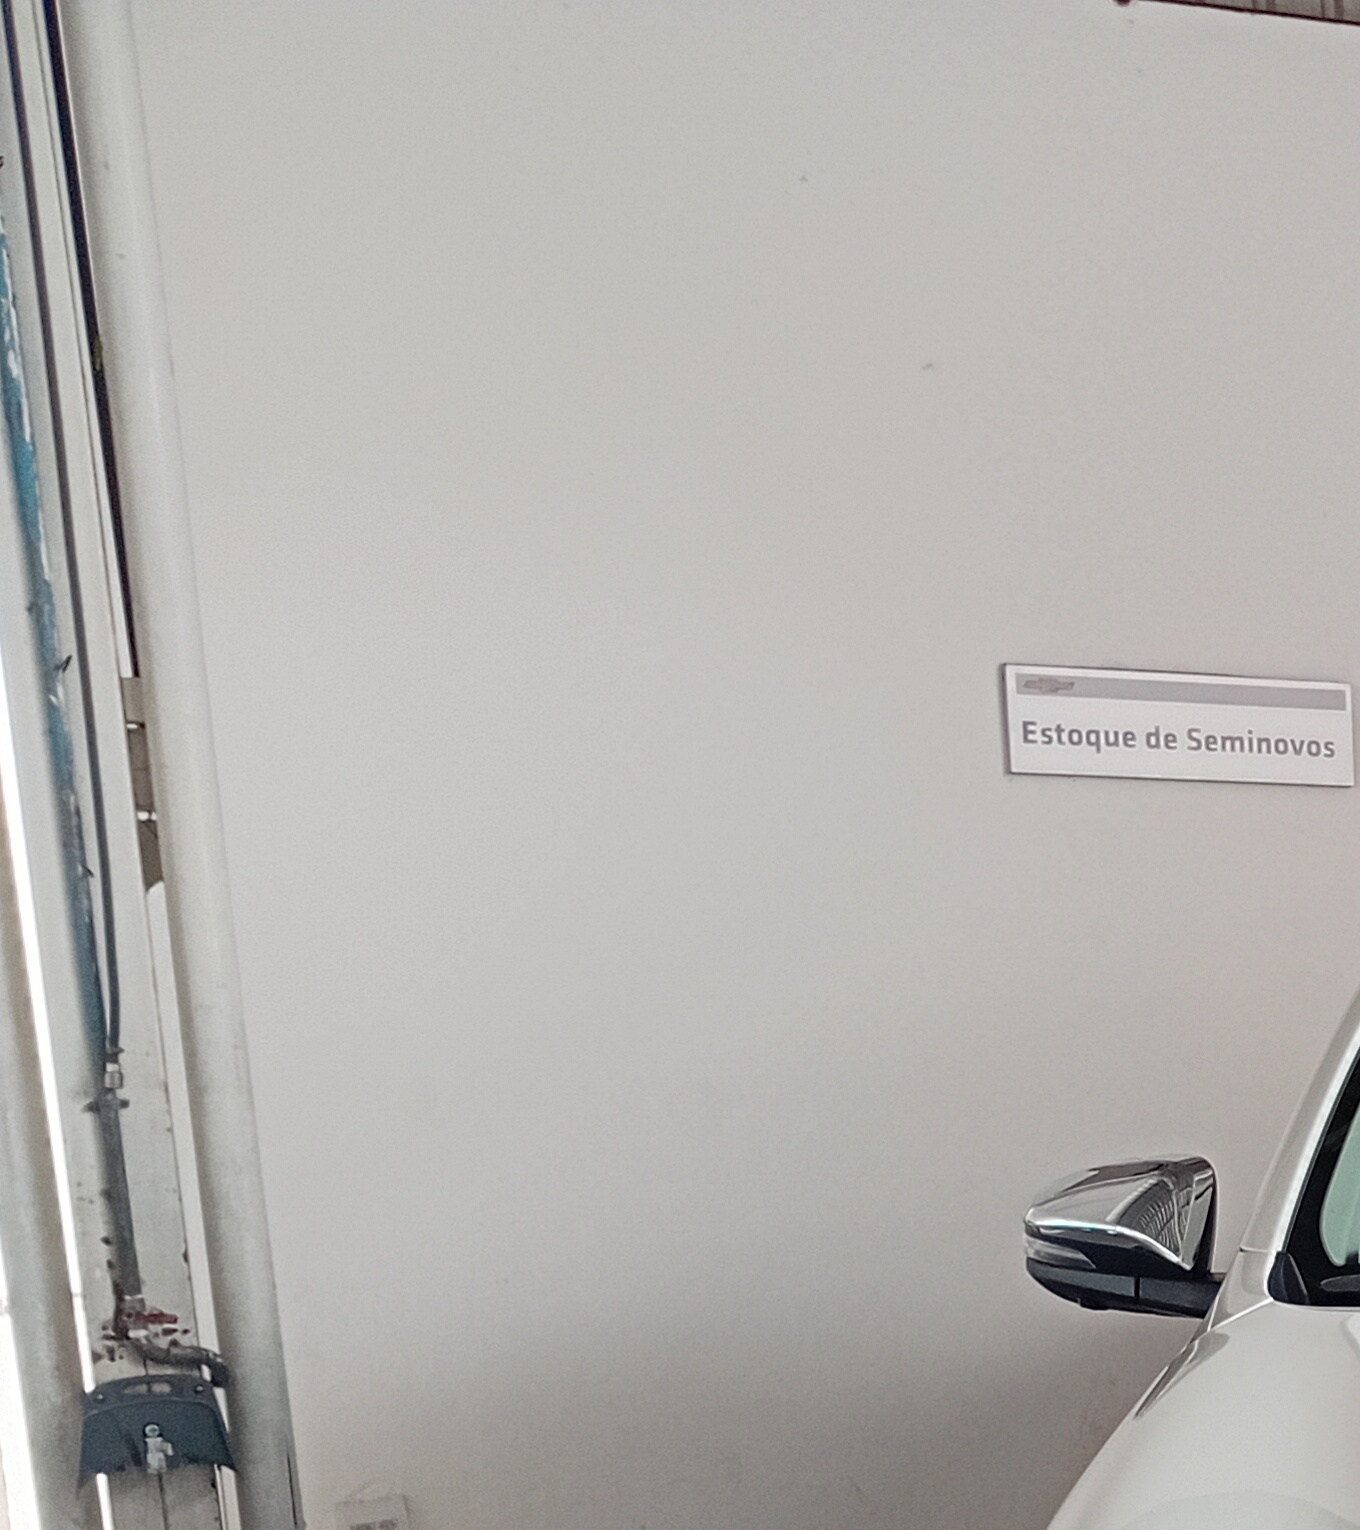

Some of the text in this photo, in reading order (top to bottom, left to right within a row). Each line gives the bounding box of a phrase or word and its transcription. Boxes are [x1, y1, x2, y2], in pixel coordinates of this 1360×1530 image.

[1021, 720, 1336, 758] Estoque de Seminovos
